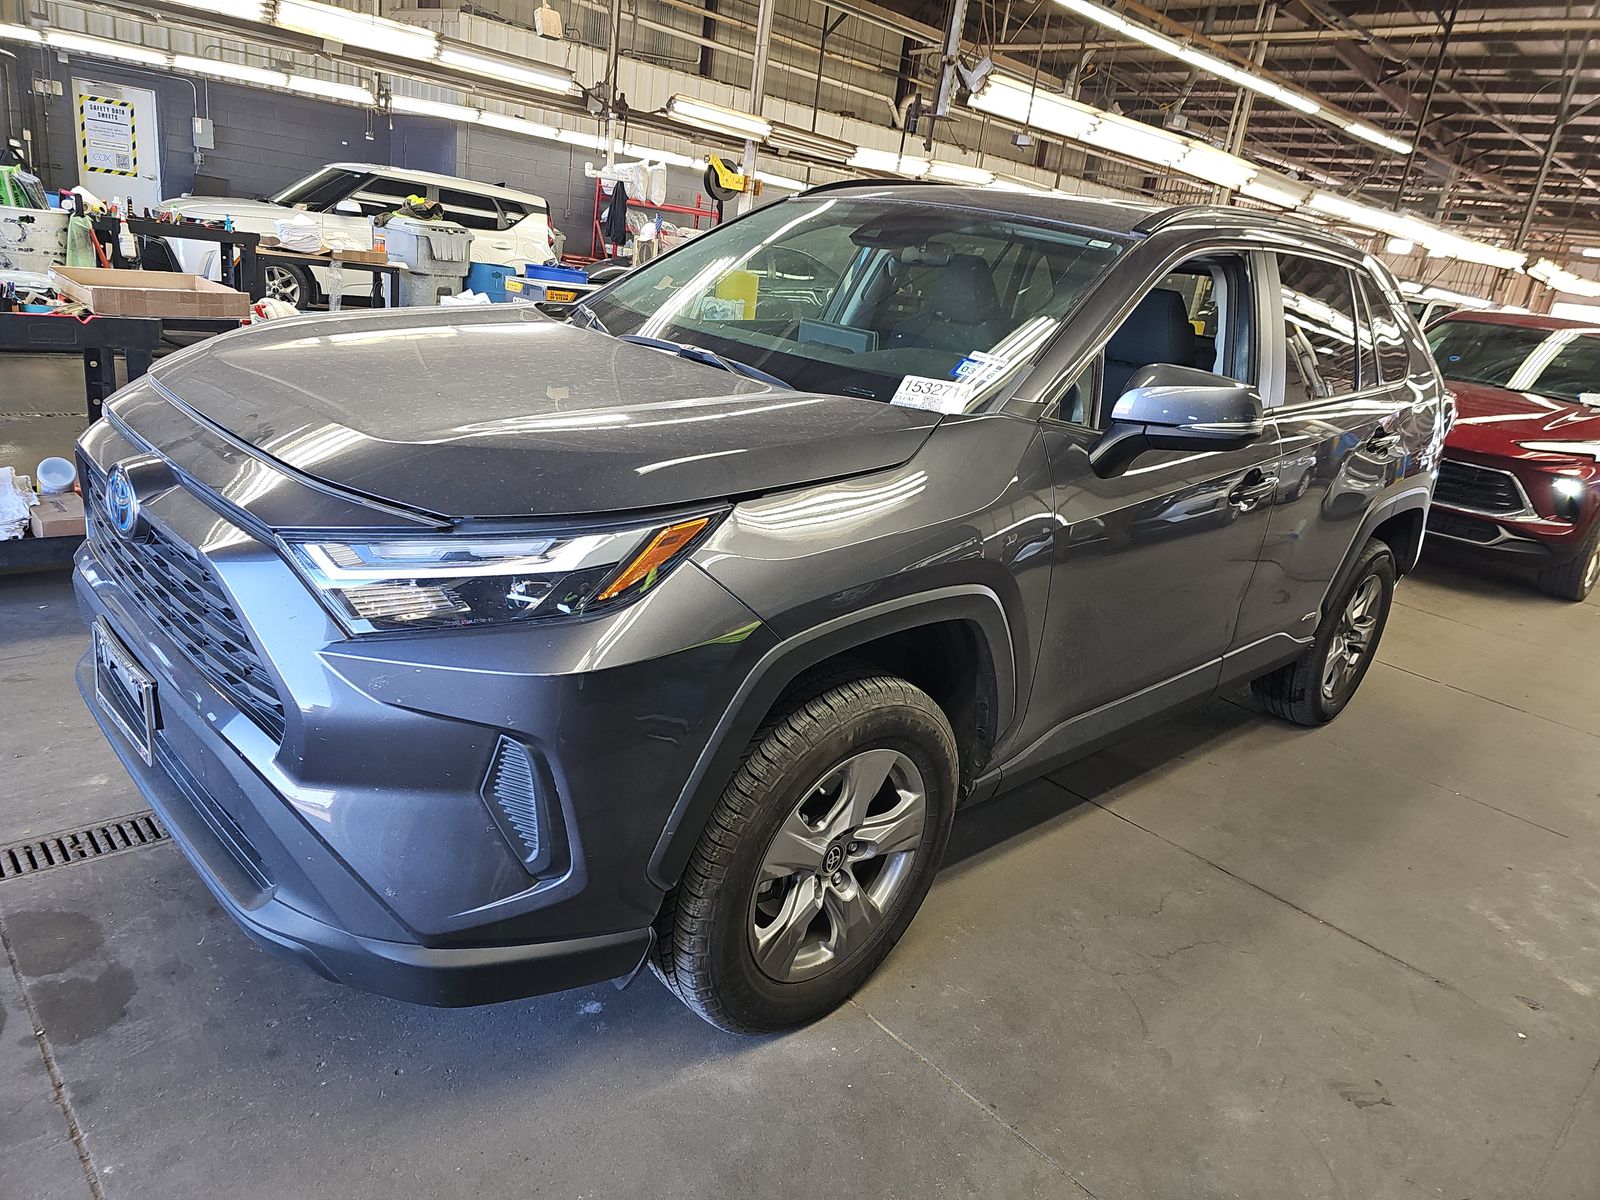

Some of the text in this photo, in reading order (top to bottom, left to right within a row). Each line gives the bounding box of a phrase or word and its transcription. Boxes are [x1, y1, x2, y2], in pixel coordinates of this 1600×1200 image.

[90, 104, 125, 115] SAFETY DATA
[98, 112, 118, 120] SHEETS
[93, 153, 113, 164] COX
[905, 379, 971, 400] 1532714
